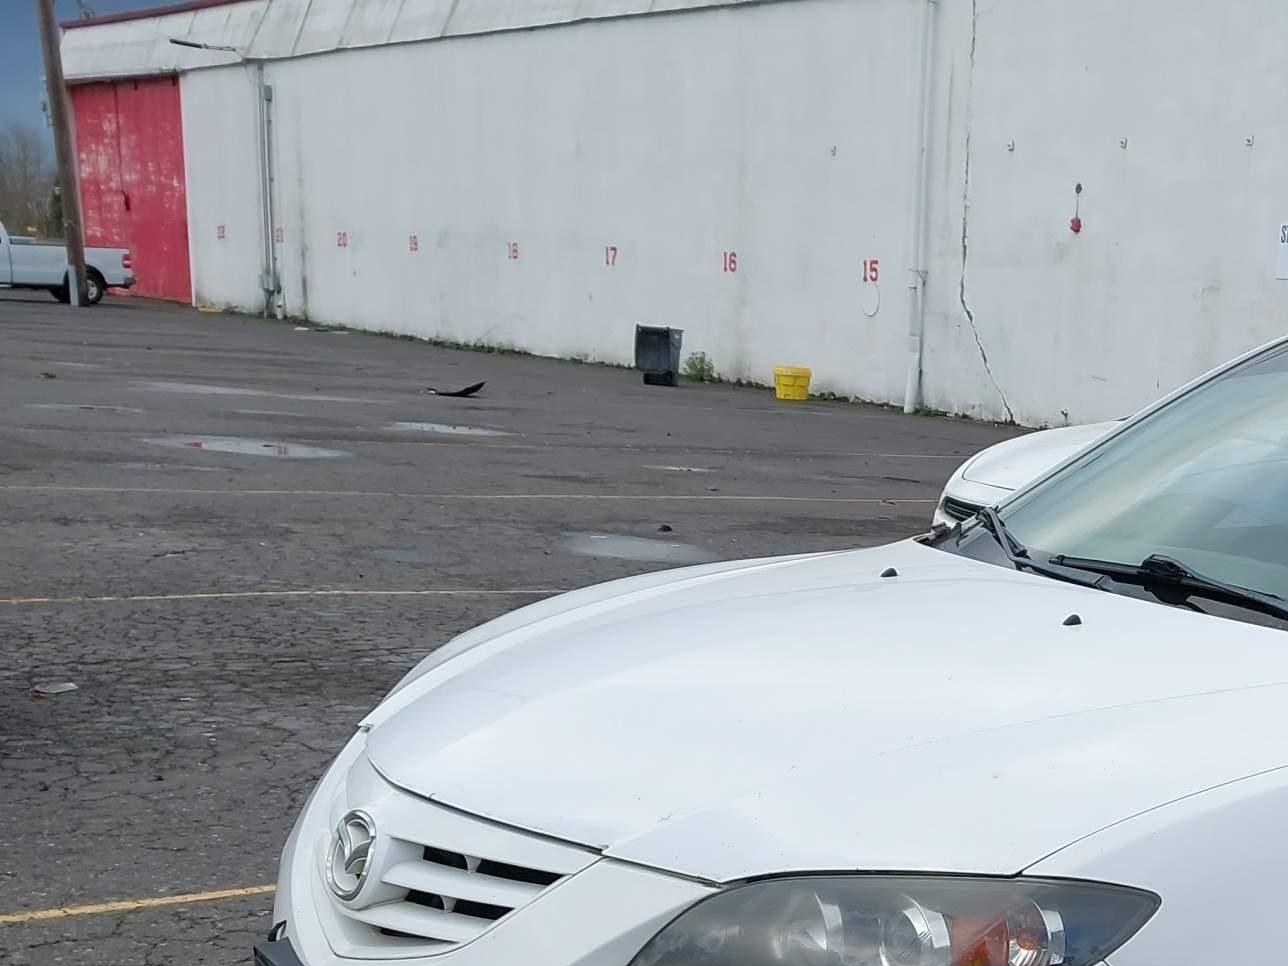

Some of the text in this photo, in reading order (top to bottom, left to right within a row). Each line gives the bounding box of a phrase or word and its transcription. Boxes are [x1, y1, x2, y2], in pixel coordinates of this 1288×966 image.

[337, 232, 347, 247] 20
[409, 235, 418, 251] 19
[508, 242, 518, 259] 18
[605, 246, 617, 265] 17
[724, 252, 736, 272] 16
[862, 260, 879, 282] 15
